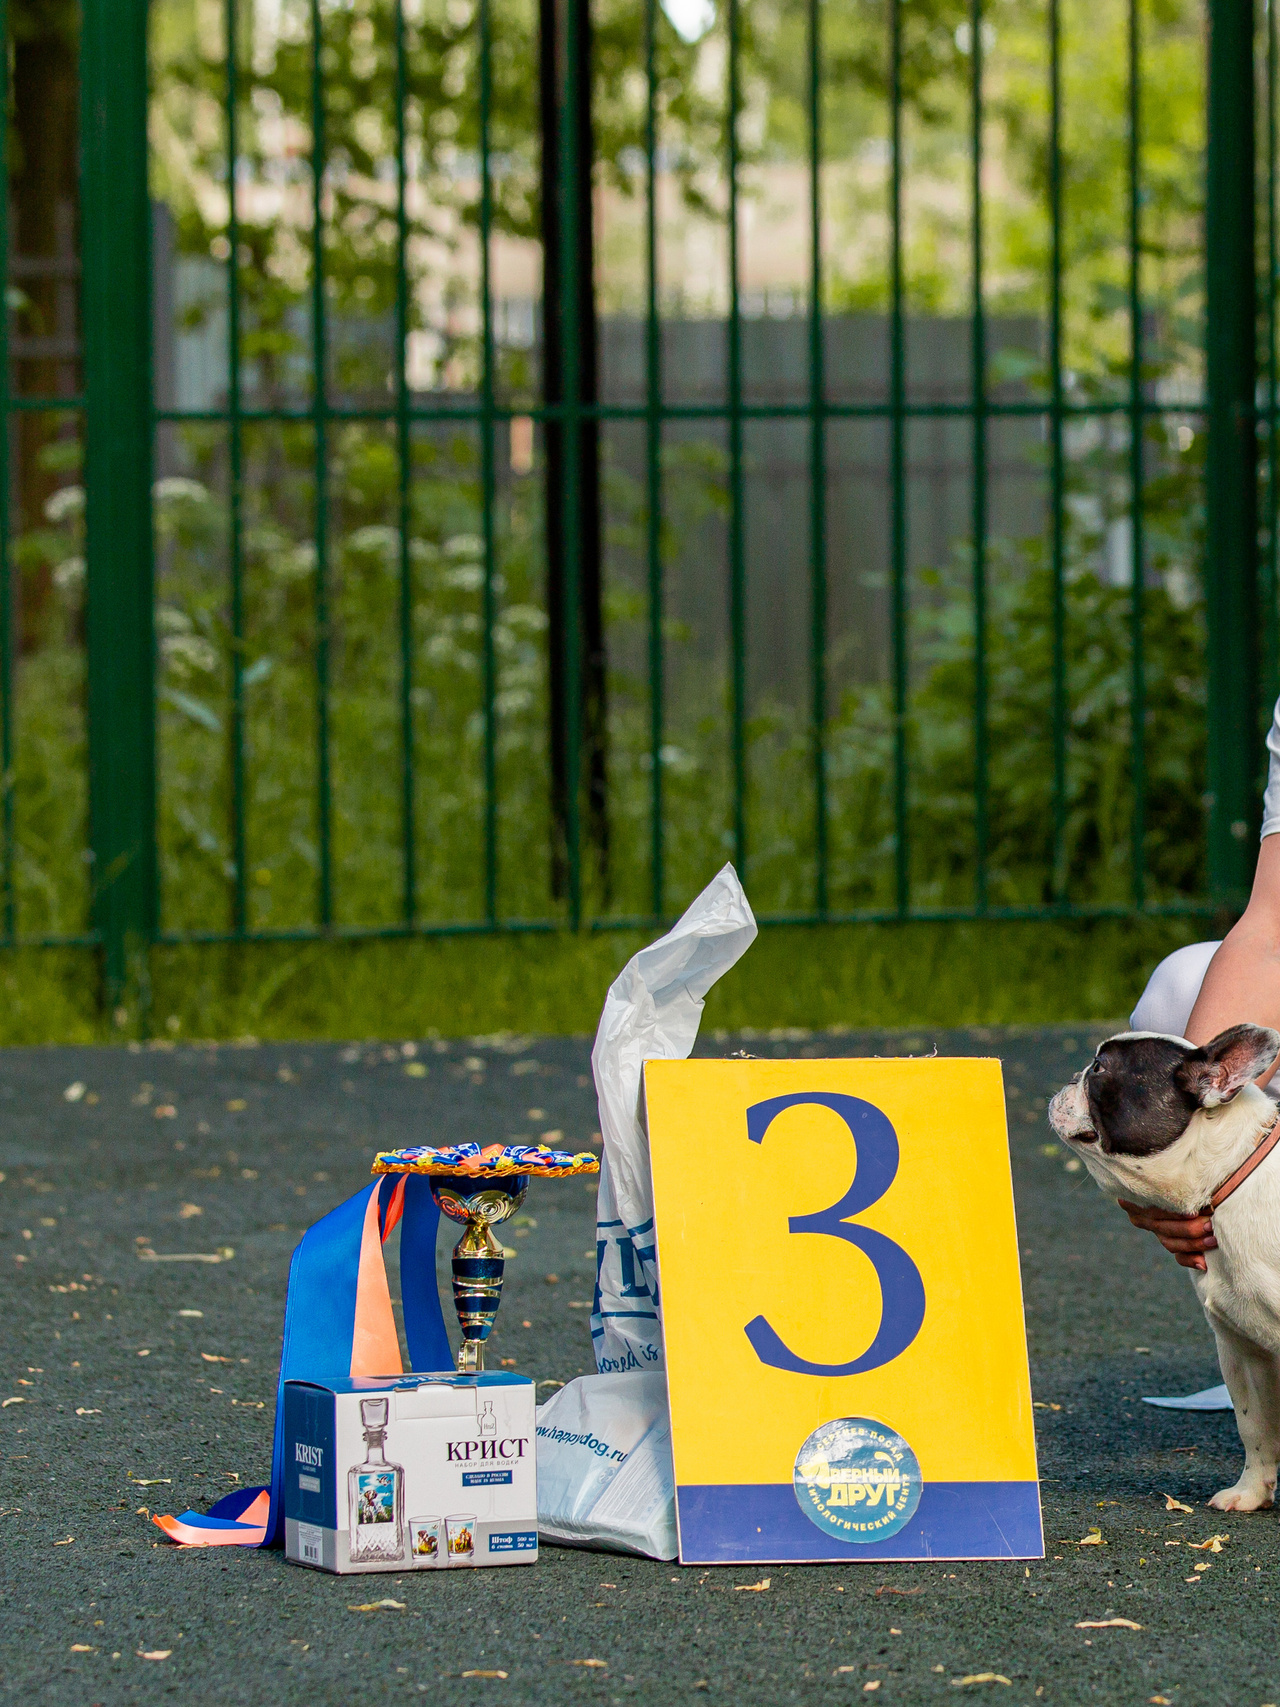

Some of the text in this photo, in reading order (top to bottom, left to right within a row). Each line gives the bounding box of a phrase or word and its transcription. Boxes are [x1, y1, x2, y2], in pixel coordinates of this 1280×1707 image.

[744, 1091, 926, 1377] 3
[295, 1442, 323, 1467] KRIST
[446, 1438, 529, 1461] КРИСТ
[816, 1427, 904, 1461] СЕРГИЕВ ПОСАД
[830, 1467, 900, 1484] ВЕРНЫЙ
[807, 1473, 910, 1532] КИНОЛОГИЧЕСКИЙ ЦЕНТР
[826, 1483, 901, 1507] ДРУГ
